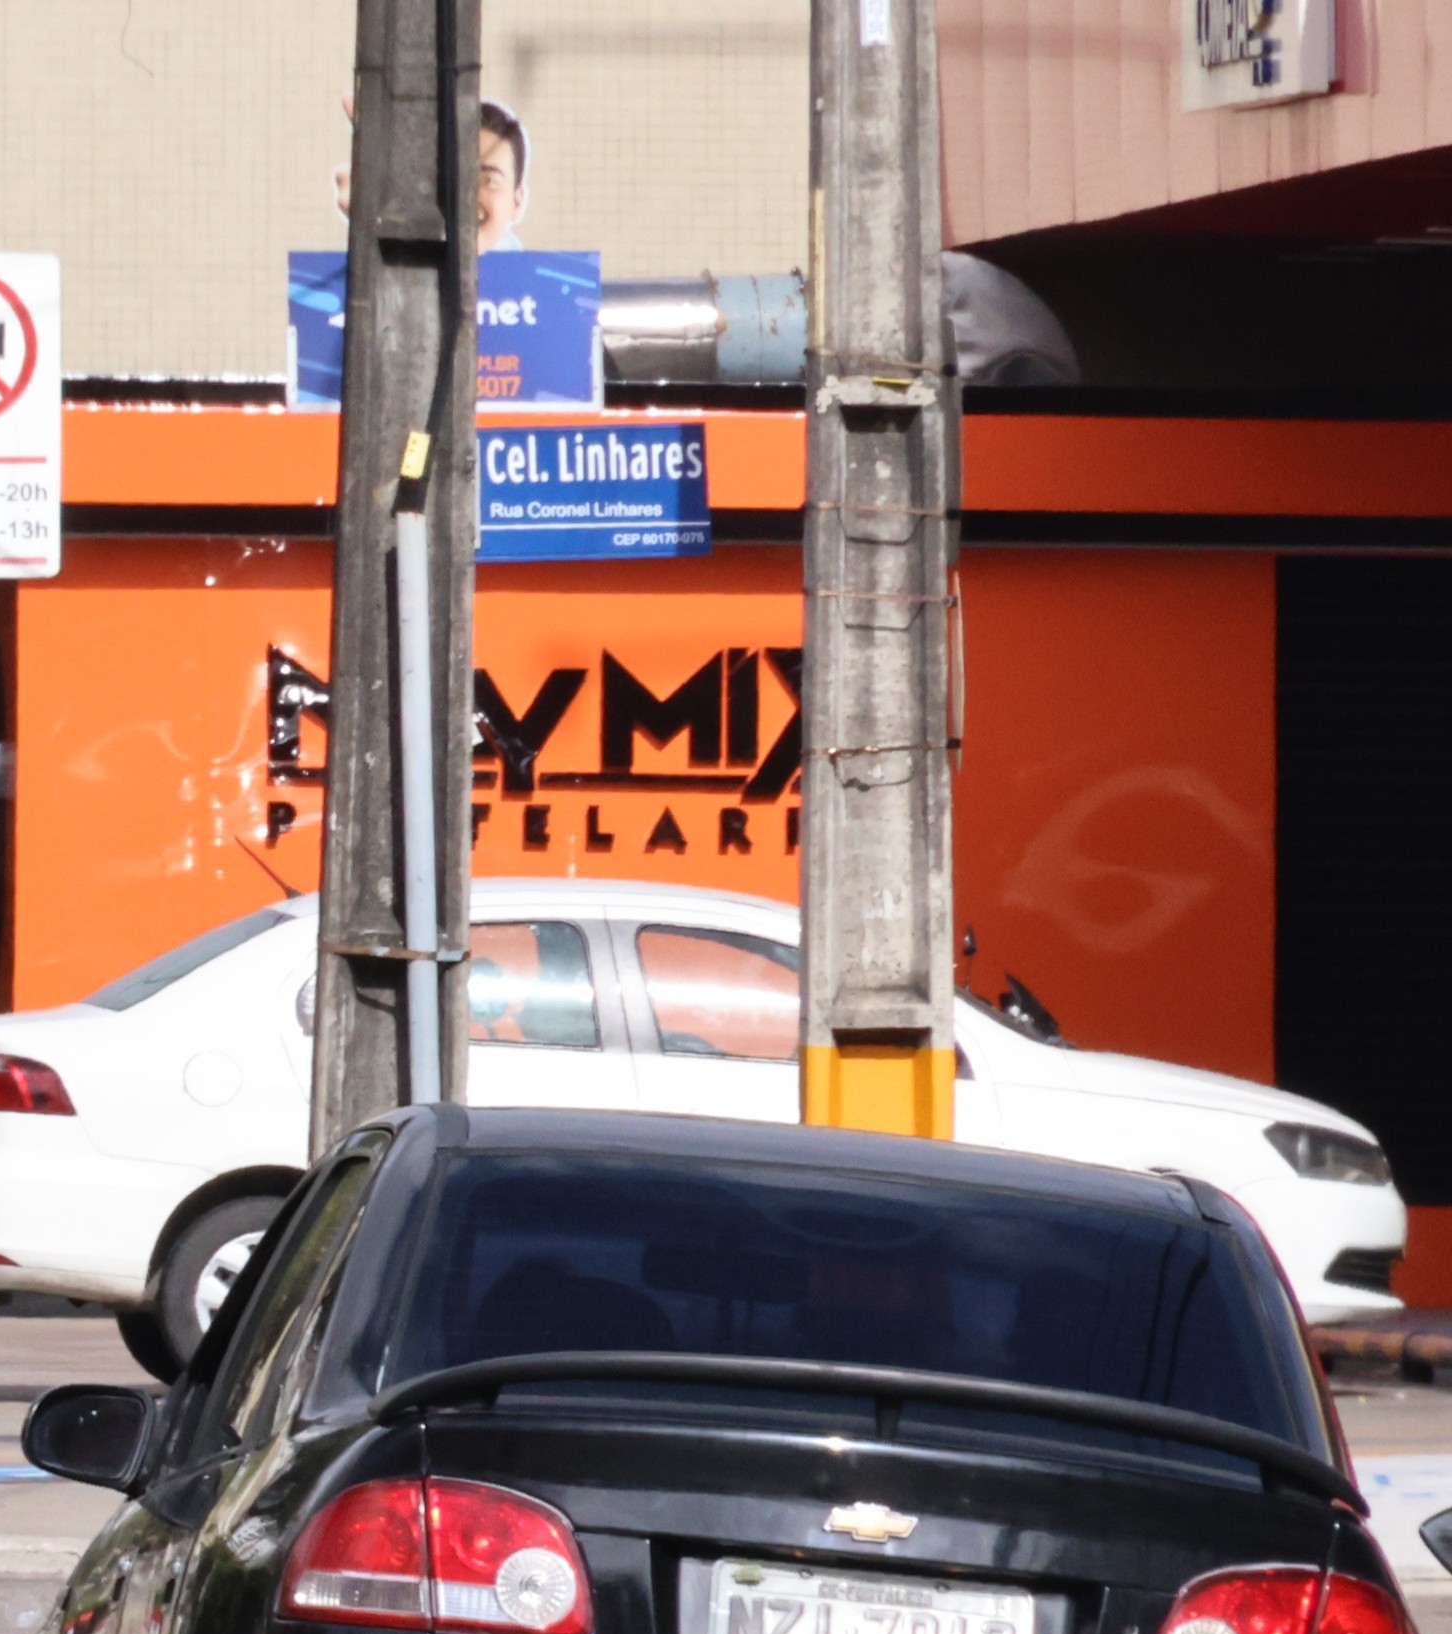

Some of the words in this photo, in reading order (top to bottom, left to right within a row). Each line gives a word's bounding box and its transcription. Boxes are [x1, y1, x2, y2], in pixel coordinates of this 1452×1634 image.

[486, 434, 549, 485] Cel.
[558, 432, 703, 484] Linhares
[490, 502, 524, 518] Rua
[527, 501, 591, 518] Coronel
[594, 501, 663, 518] Linhares
[613, 533, 641, 546] CEP
